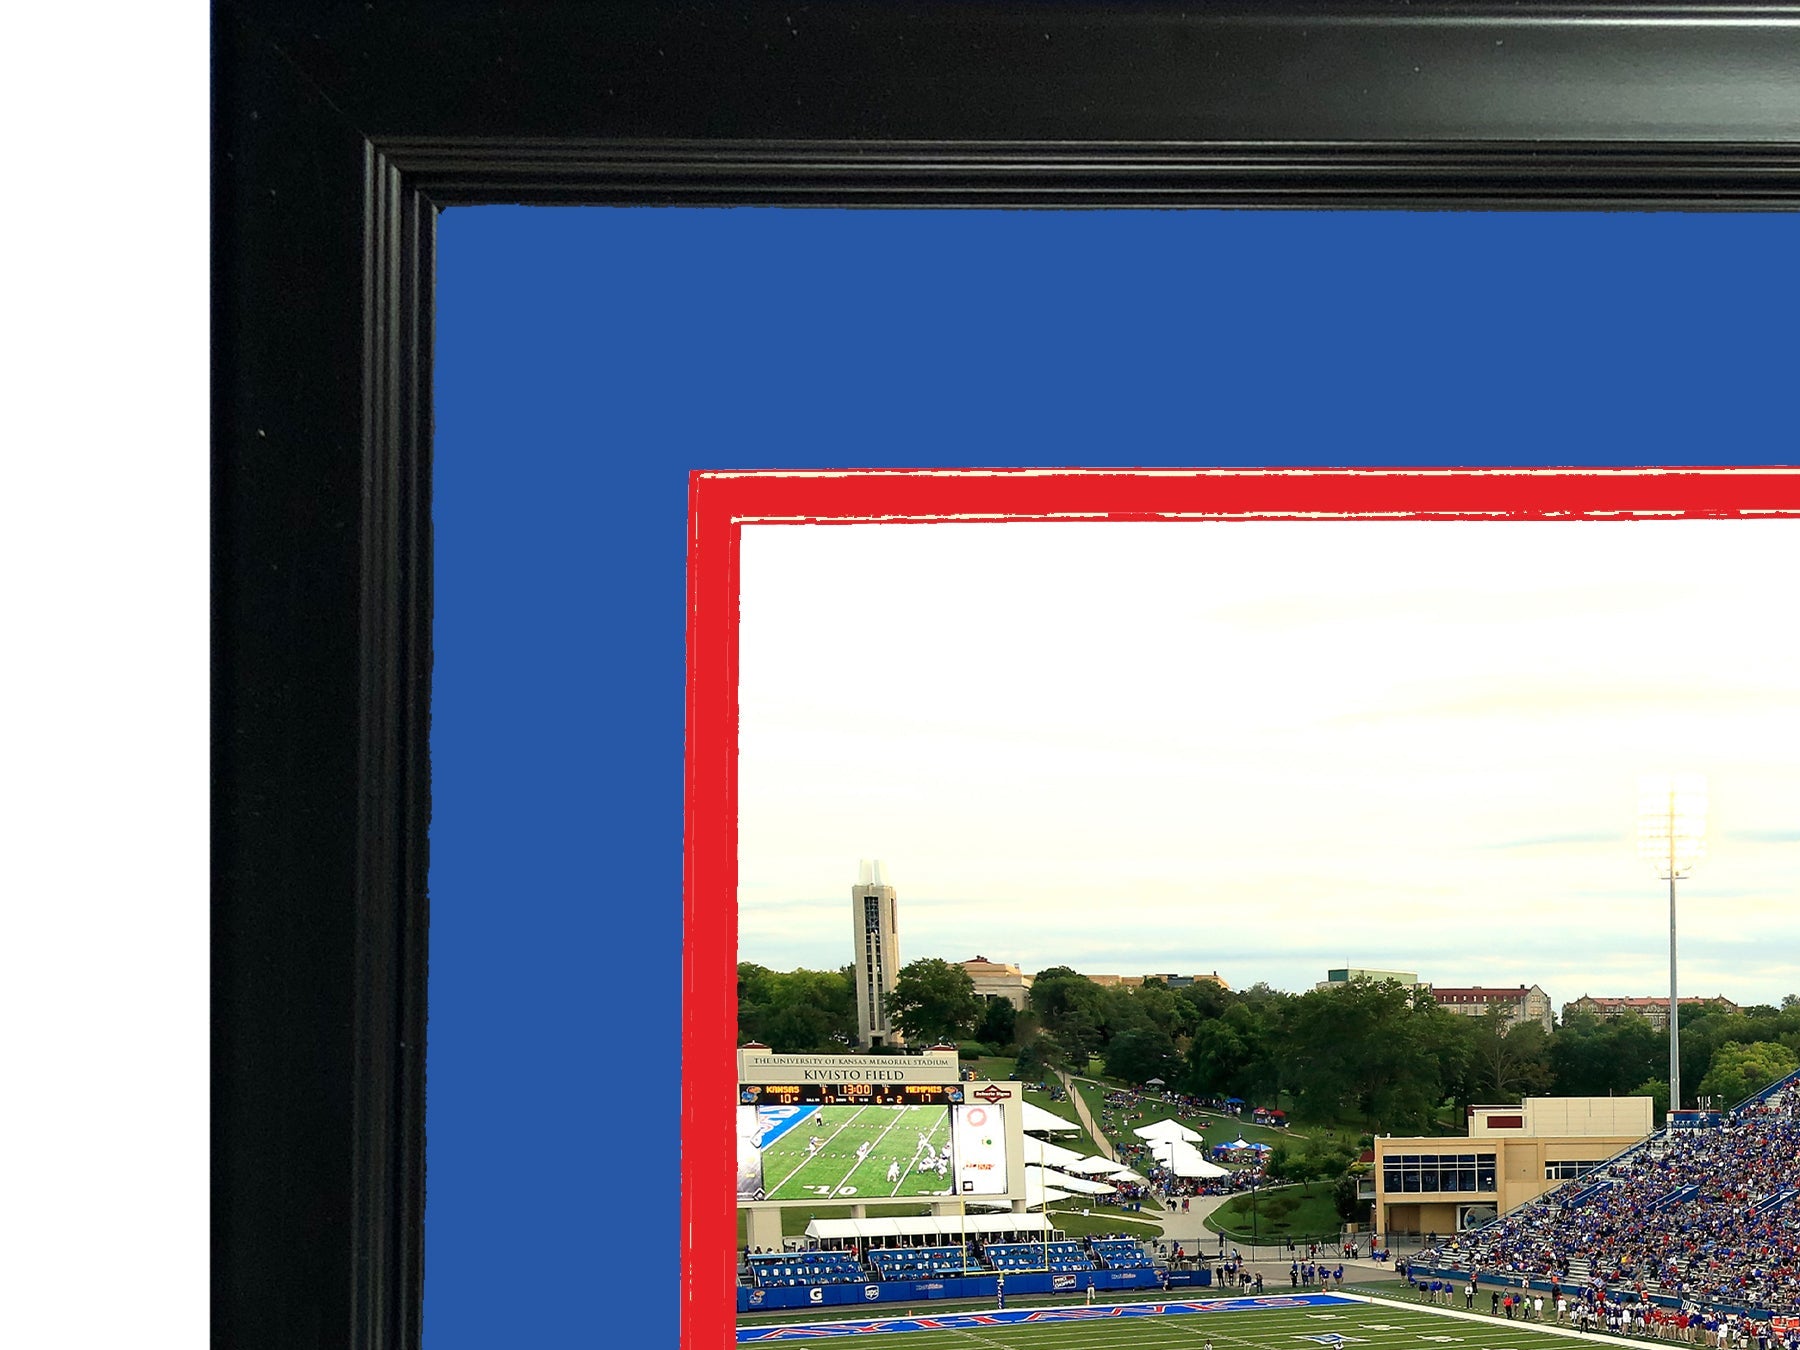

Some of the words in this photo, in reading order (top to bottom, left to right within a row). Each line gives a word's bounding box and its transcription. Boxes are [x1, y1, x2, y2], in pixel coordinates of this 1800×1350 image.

[754, 1057, 770, 1065] THE
[773, 1057, 824, 1066] UNIVERSITY
[825, 1058, 836, 1066] OF
[839, 1058, 867, 1066] KANSAS
[913, 1059, 949, 1067] STADIUM
[804, 1069, 861, 1081] KIVISTO
[865, 1070, 905, 1081] FIELD
[766, 1086, 800, 1094] KANSAS
[843, 1084, 870, 1095] 13:00
[905, 1085, 943, 1094] MEMPHIS
[780, 1094, 792, 1104] 10
[825, 1095, 835, 1104] 17
[921, 1093, 932, 1103] 17
[809, 1287, 823, 1301] G
